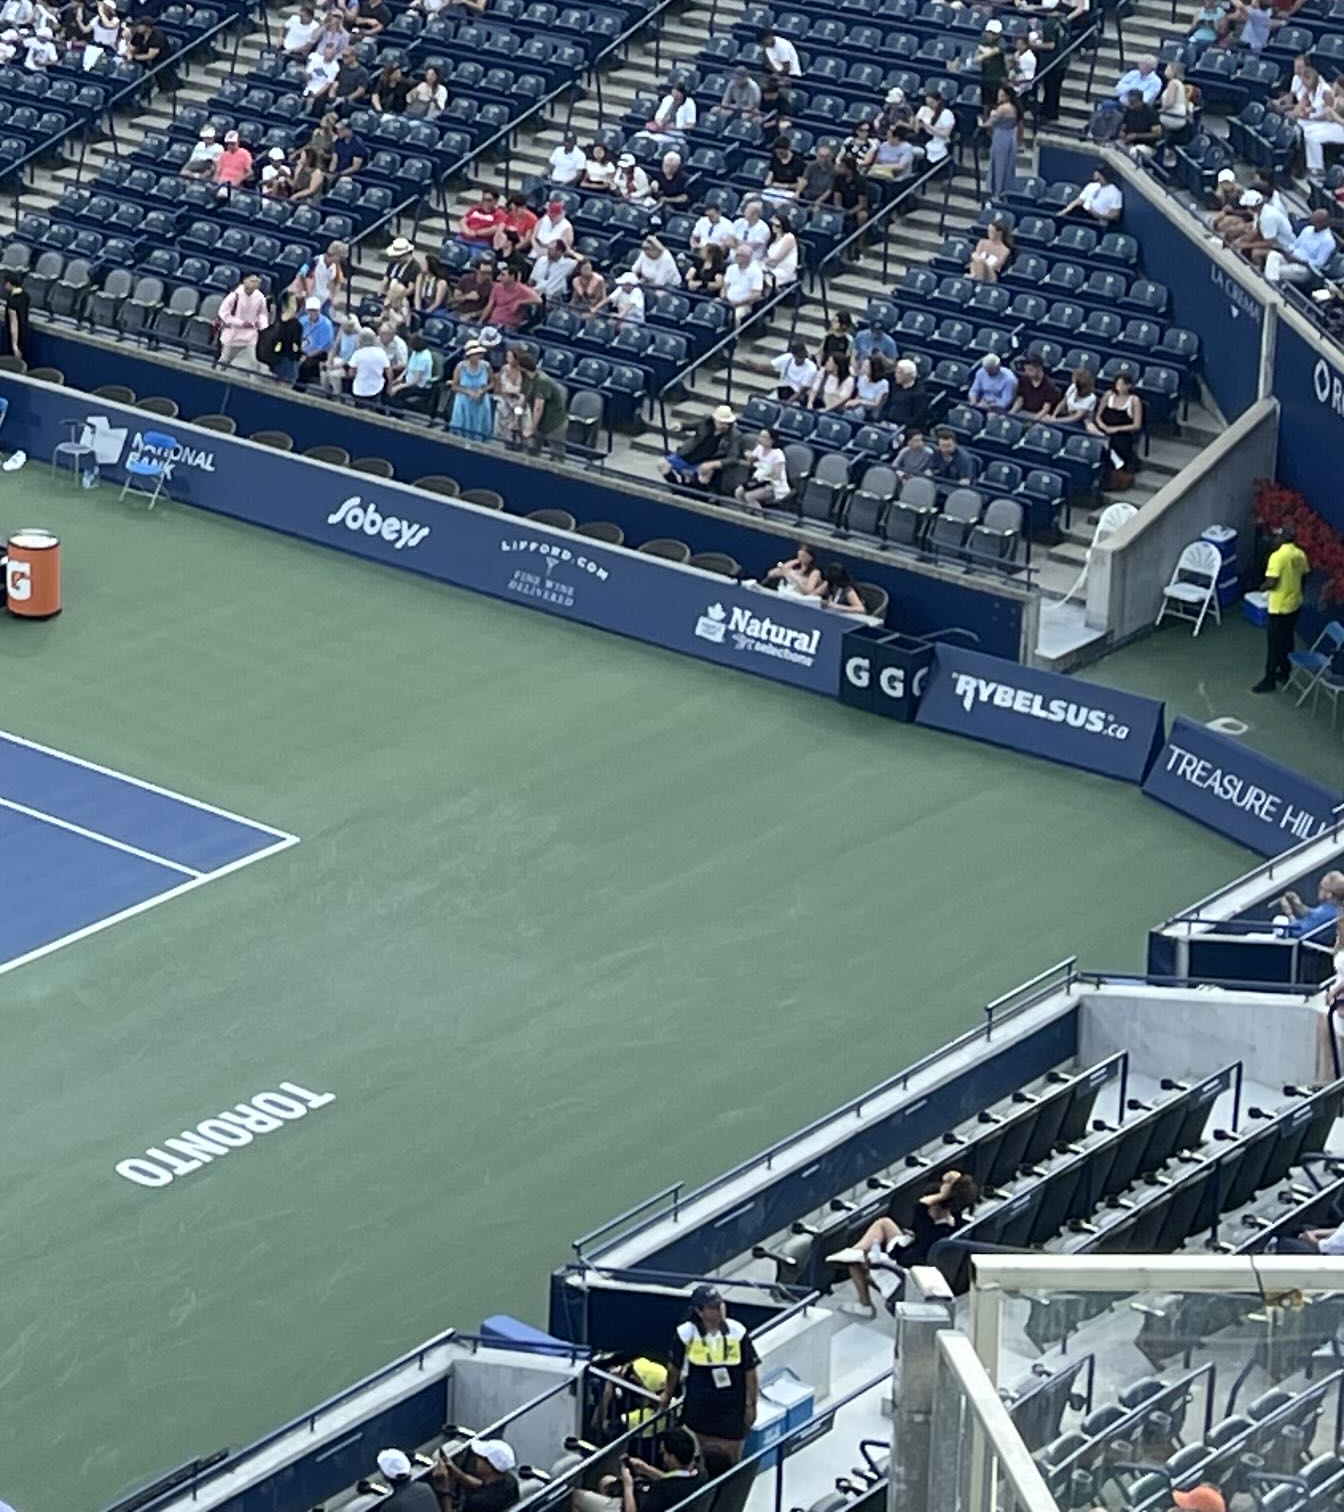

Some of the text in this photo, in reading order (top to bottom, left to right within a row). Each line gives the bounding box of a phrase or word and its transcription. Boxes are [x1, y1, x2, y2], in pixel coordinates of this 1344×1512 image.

[327, 495, 430, 551] Sobeys
[7, 561, 31, 600] G
[501, 540, 609, 581] LIFFORD.COM
[728, 606, 820, 655] Natural
[845, 656, 870, 688] G
[879, 667, 905, 698] G
[1167, 744, 1283, 822] TREASURE
[115, 1081, 337, 1187] TORONTO
